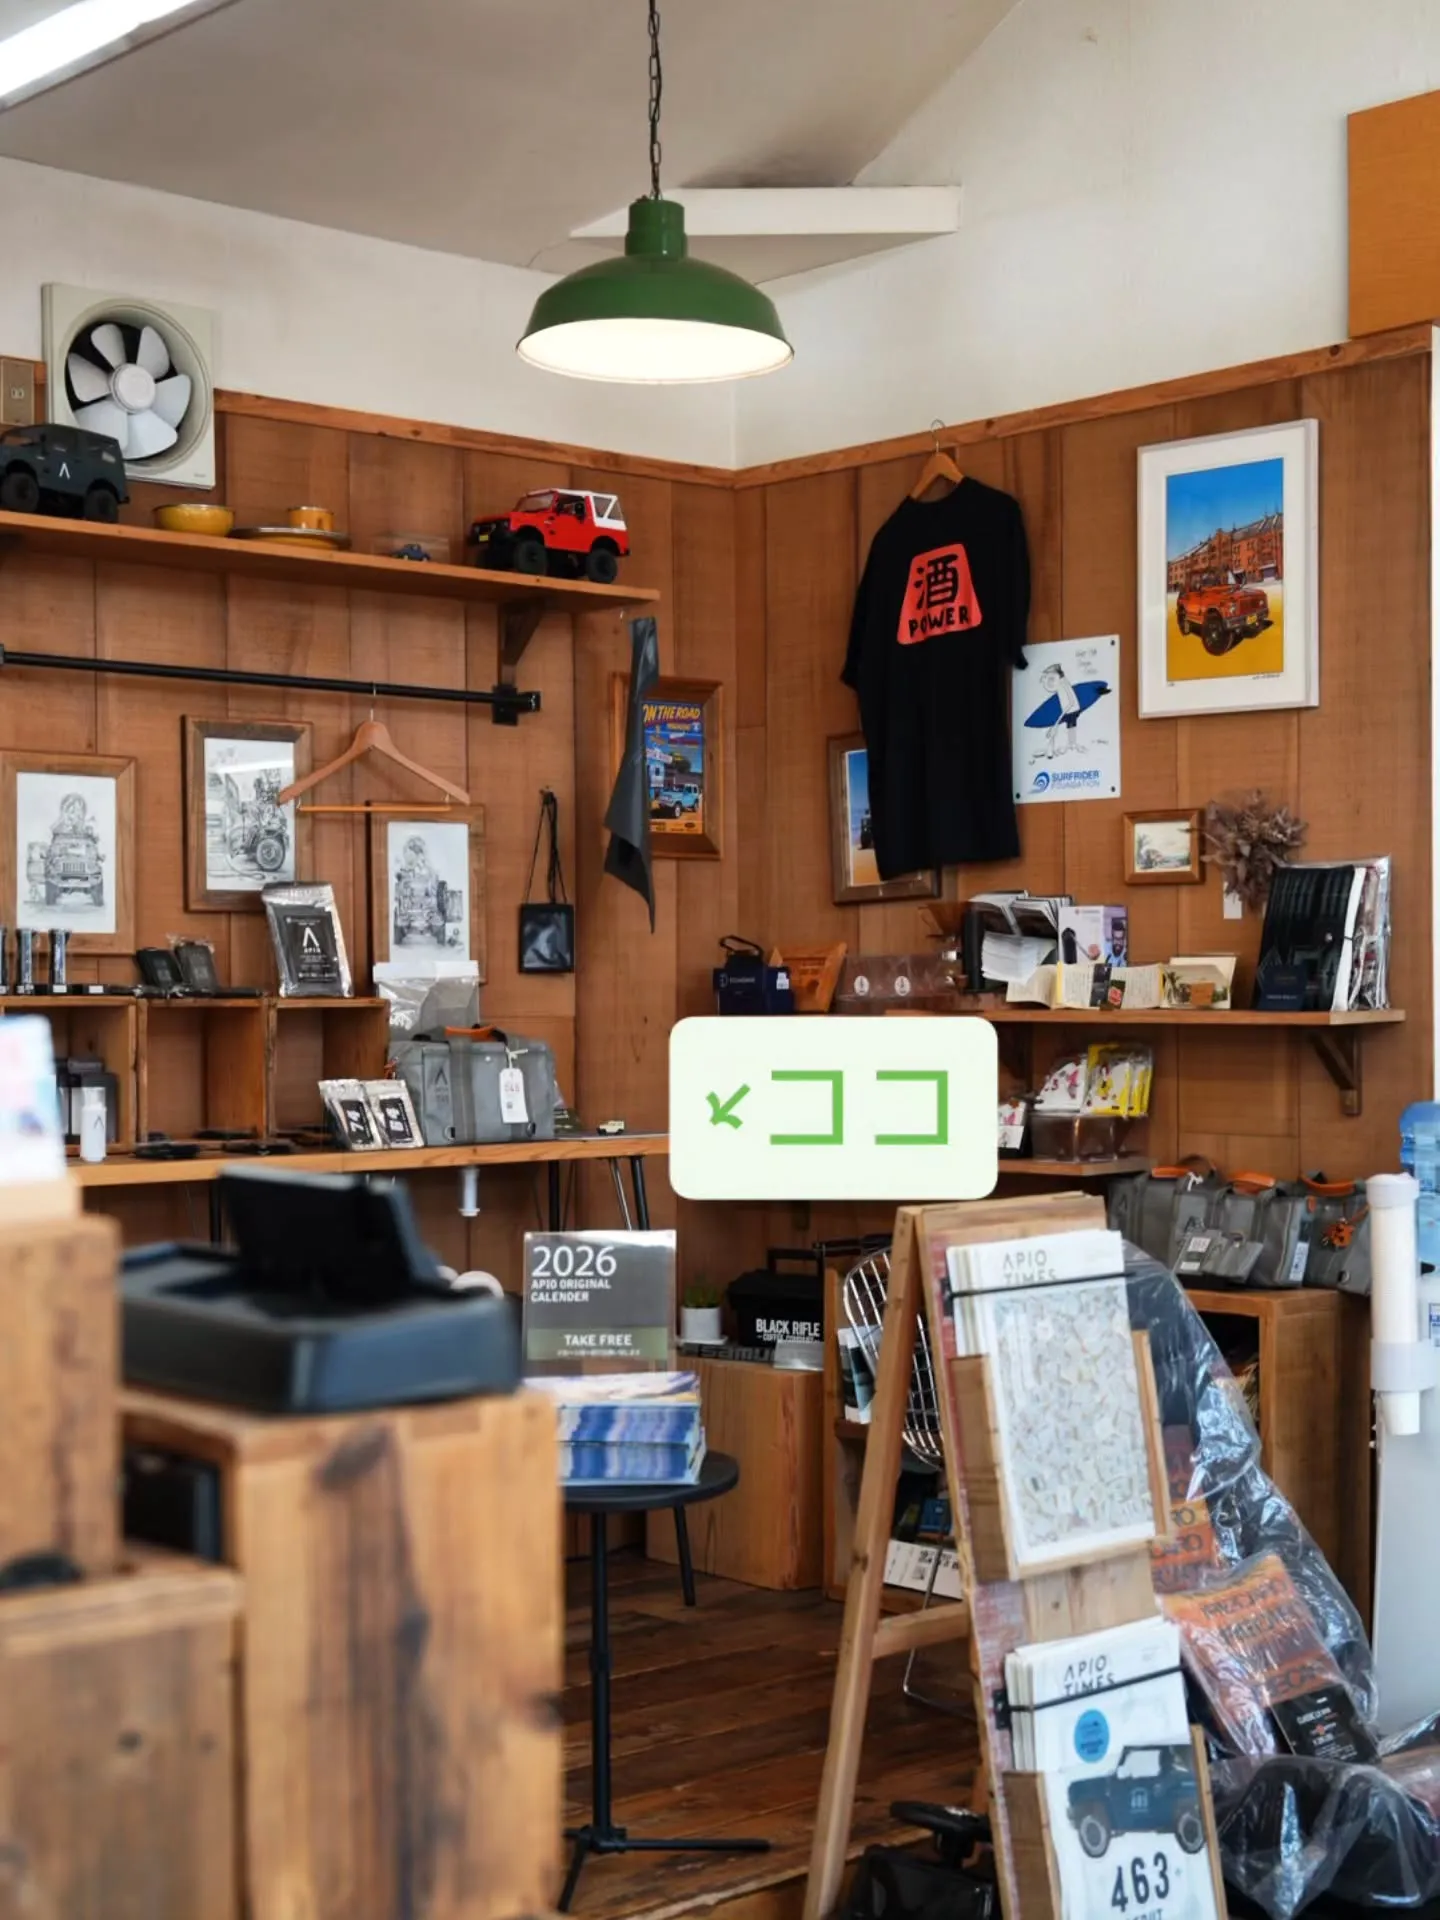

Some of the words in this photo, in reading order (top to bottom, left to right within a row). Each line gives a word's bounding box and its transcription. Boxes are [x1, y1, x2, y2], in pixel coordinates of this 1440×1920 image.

[913, 553, 959, 611] 酒
[908, 605, 970, 638] POWER
[658, 704, 675, 720] THE
[675, 706, 701, 720] ROAD
[1051, 770, 1100, 782] SURFRIDER
[531, 1245, 617, 1277] 2026
[1002, 1250, 1048, 1270] APIO
[530, 1278, 558, 1290] APIO
[559, 1278, 612, 1290] ORIGINAL
[530, 1290, 590, 1302] CALENDER
[755, 1318, 790, 1334] BLACK
[792, 1321, 821, 1337] RIFLE
[564, 1334, 597, 1346] TAKE
[599, 1334, 632, 1346] FREE
[1064, 1655, 1108, 1682] APIO
[1065, 1672, 1115, 1696] TIMES
[1111, 1851, 1170, 1913] 463
